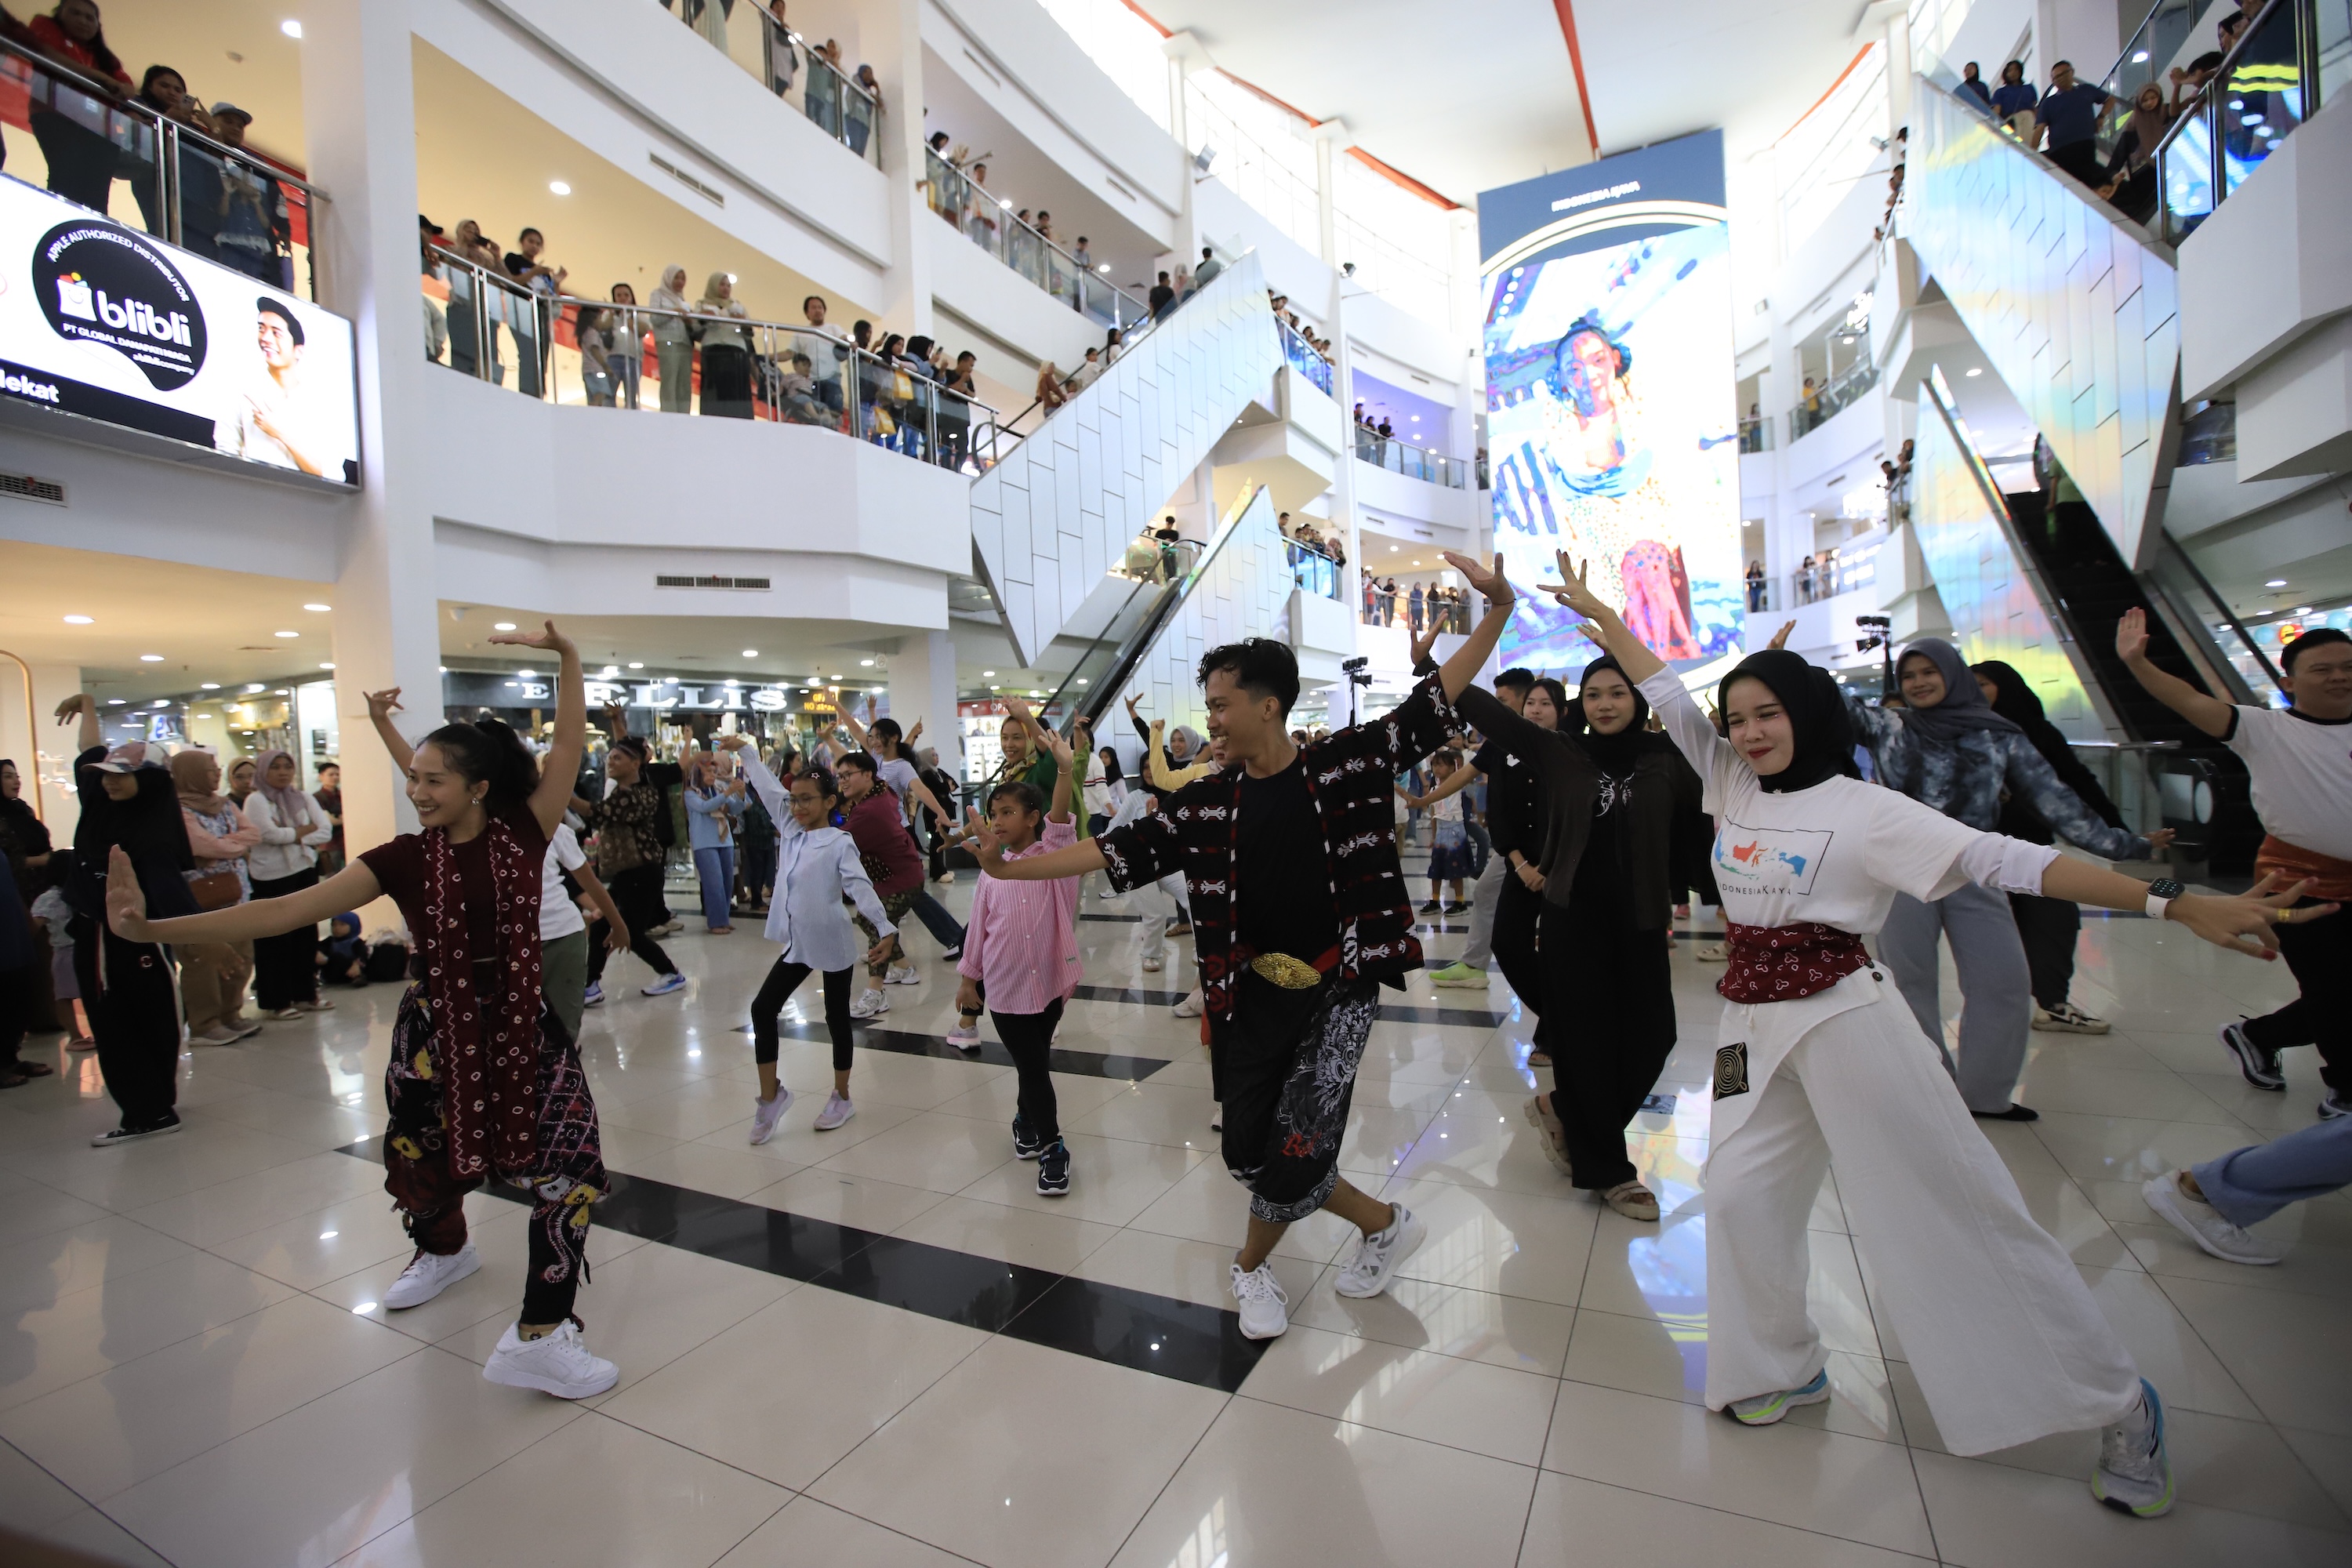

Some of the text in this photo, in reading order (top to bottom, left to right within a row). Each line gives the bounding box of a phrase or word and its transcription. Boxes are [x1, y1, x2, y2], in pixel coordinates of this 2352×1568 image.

[47, 229, 190, 303] APPLE AUTHORIZED DISTRIBUTOR
[62, 322, 78, 335] PT
[78, 327, 118, 345] GLOBAL
[96, 290, 192, 347] blibli
[583, 681, 787, 711] ELLIS
